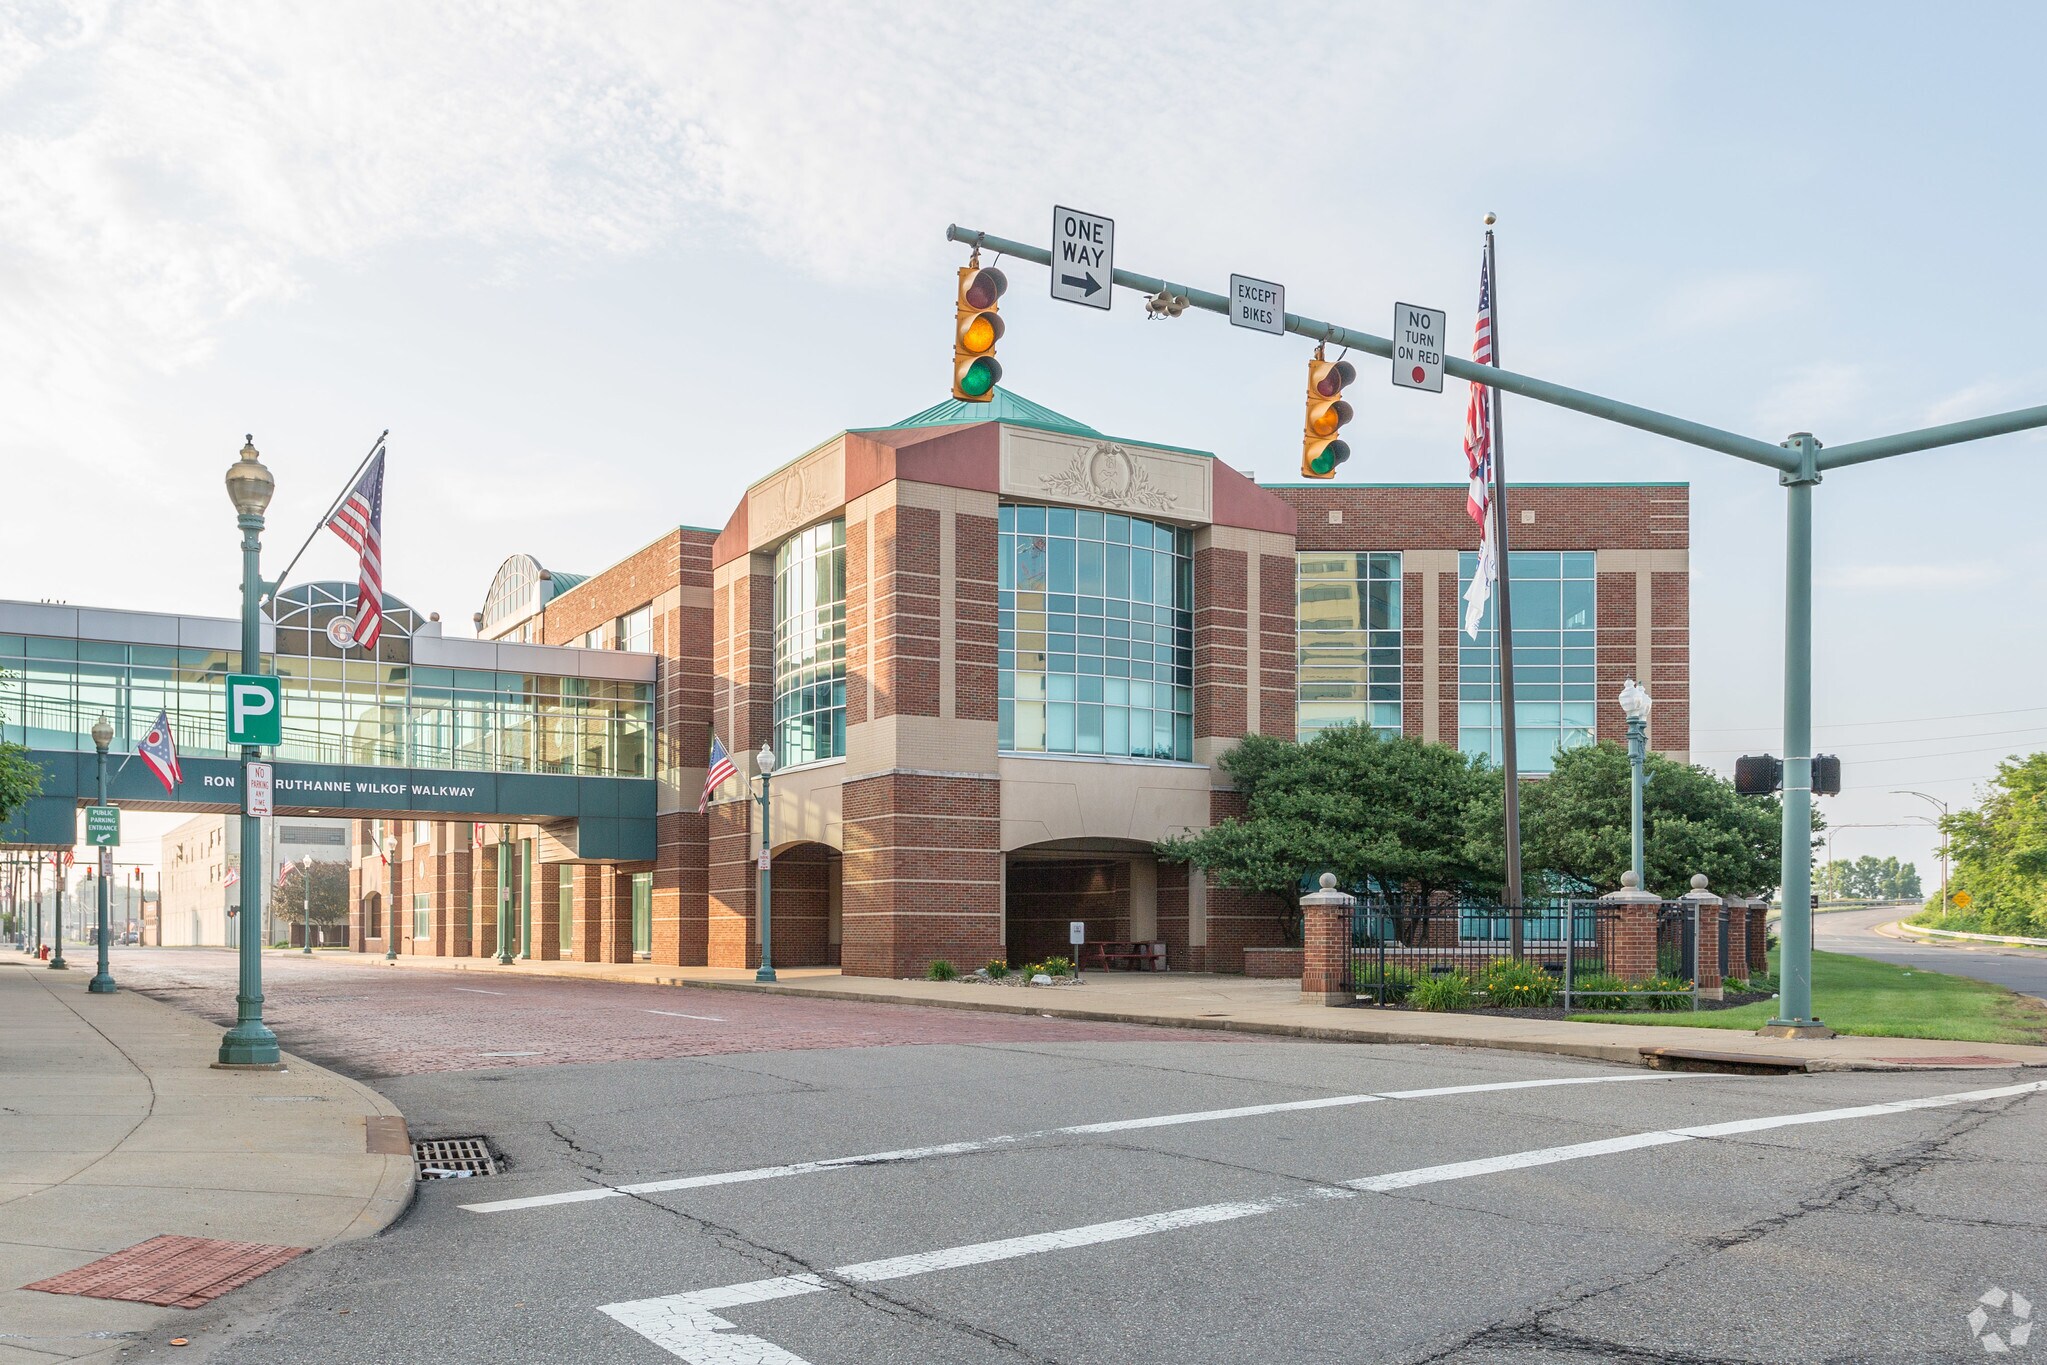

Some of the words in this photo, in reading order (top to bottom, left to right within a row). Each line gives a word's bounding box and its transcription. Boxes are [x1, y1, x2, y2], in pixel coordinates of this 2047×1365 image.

[1064, 217, 1104, 245] ONE
[1062, 240, 1104, 268] WAY
[1238, 284, 1277, 305] EXCEPT
[1242, 305, 1273, 325] BIKES
[1409, 311, 1431, 330] NO
[1405, 330, 1434, 348] TURN
[1398, 346, 1414, 361] ON
[1418, 350, 1440, 365] RED
[233, 684, 275, 734] P
[255, 767, 265, 779] NO
[204, 775, 235, 787] RON
[275, 778, 352, 792] RUTHANNE
[356, 782, 407, 795] WILKOF
[411, 785, 476, 797] WALKWAY
[250, 779, 269, 790] PARKING
[255, 790, 265, 798] ANY
[254, 798, 266, 807] TIME
[88, 824, 118, 832] ENTRANCE
